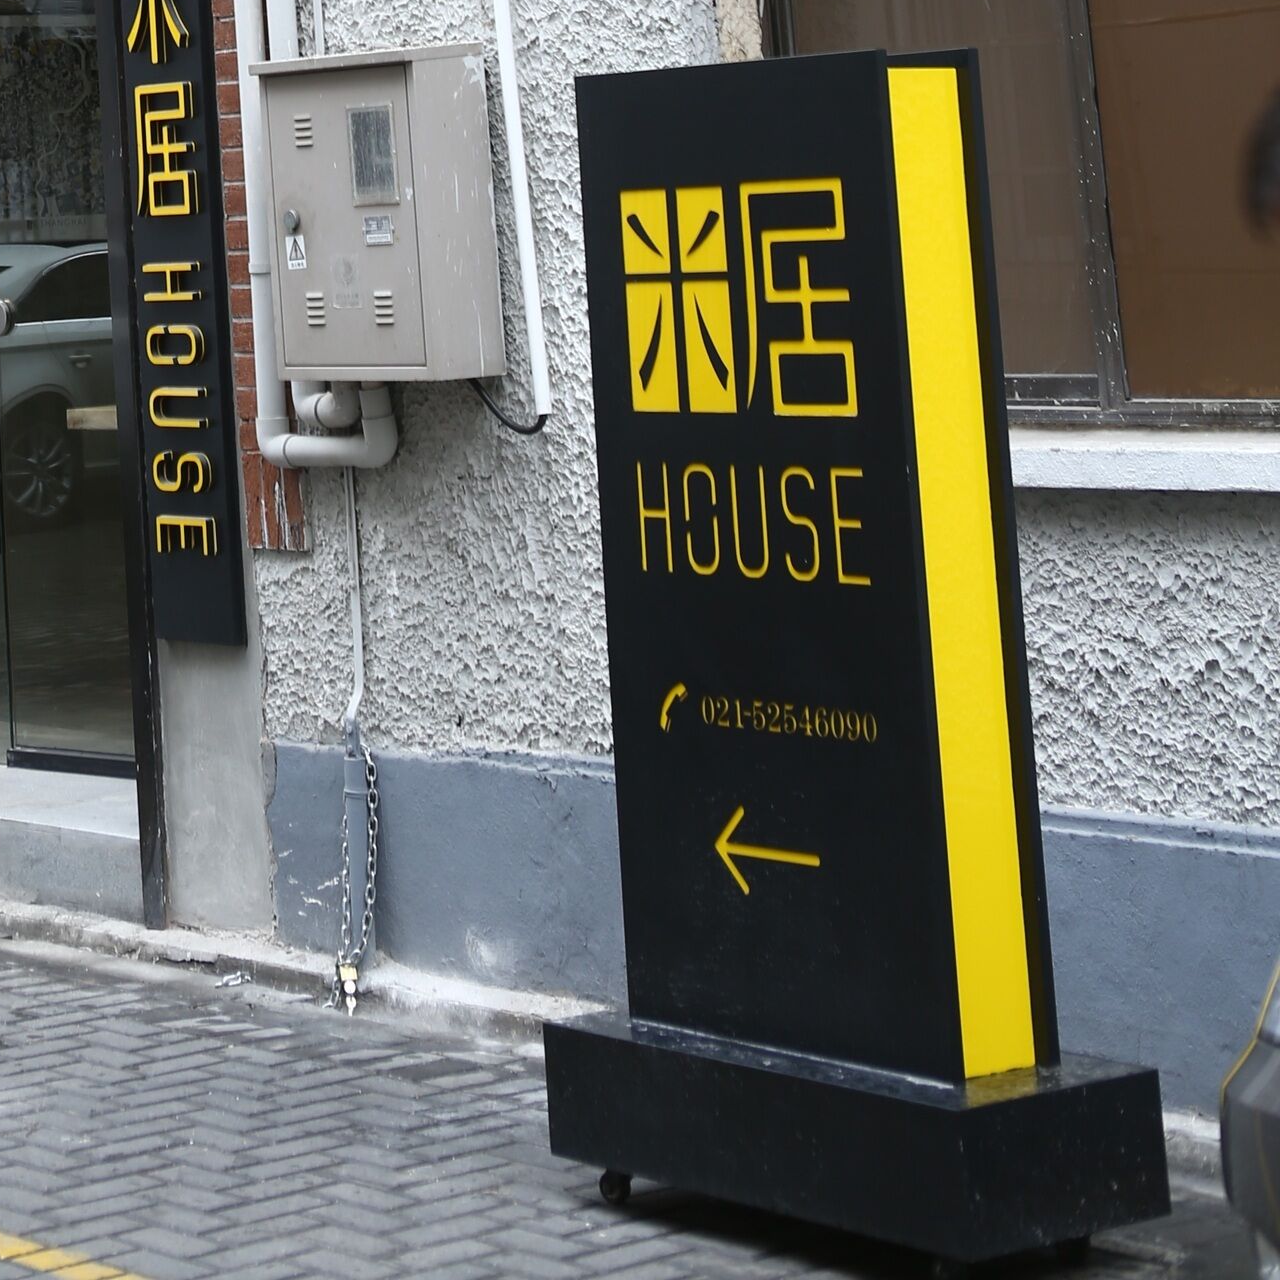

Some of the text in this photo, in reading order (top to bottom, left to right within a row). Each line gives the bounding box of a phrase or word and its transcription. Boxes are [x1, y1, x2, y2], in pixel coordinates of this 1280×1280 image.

[620, 177, 859, 418] 米居
[142, 261, 218, 557] HOUSE
[636, 462, 872, 587] HOUSE
[701, 695, 878, 743] 021-52546090
